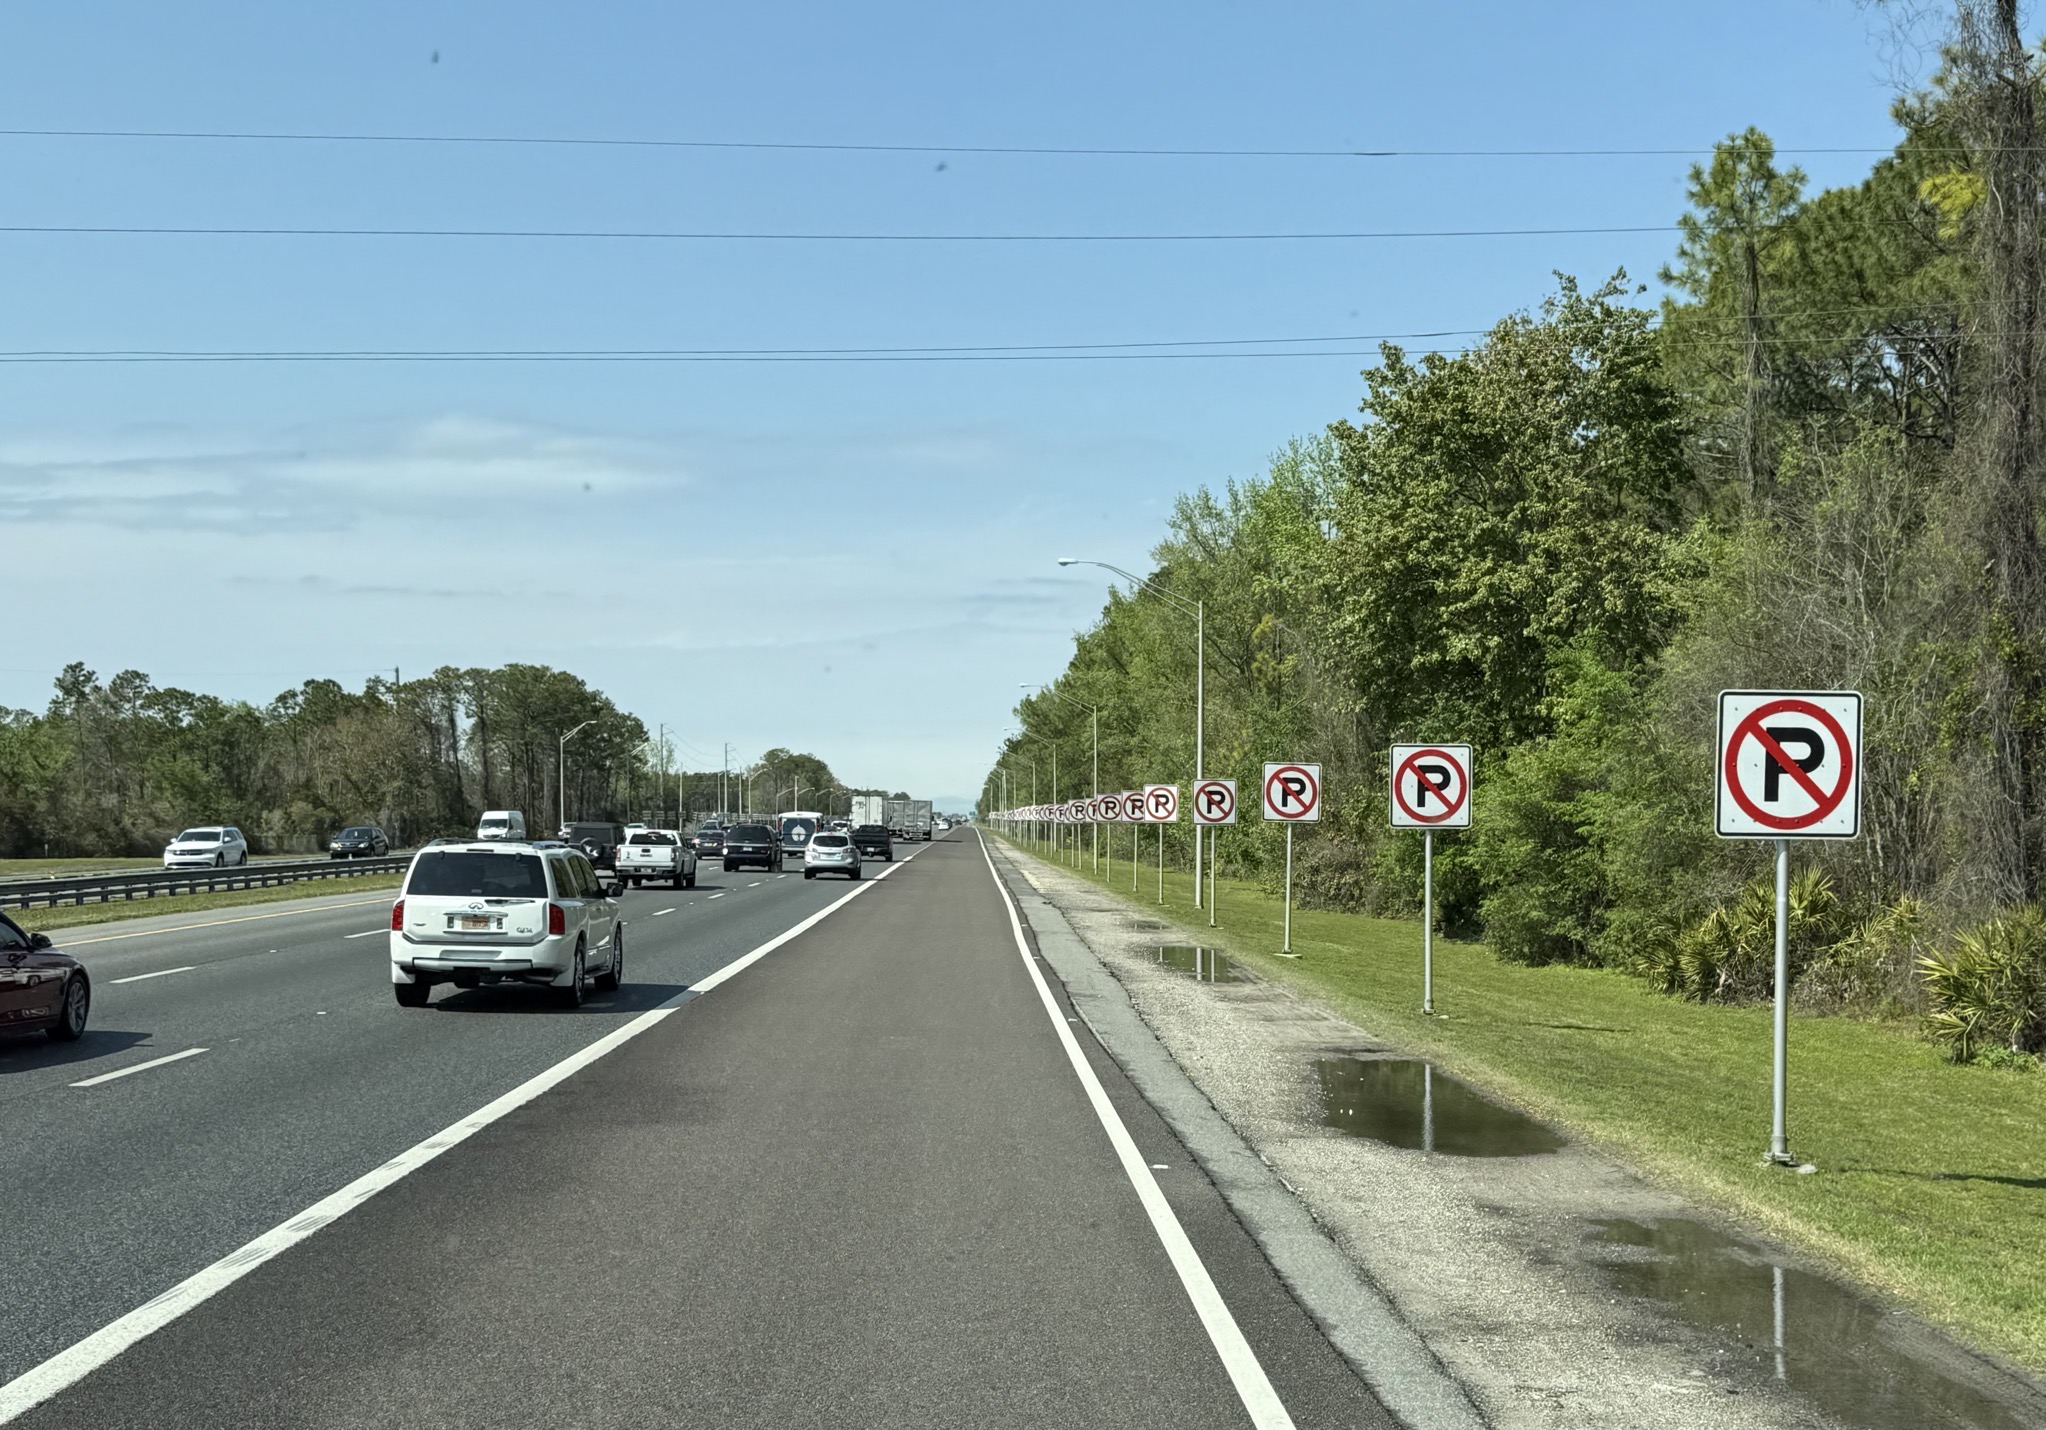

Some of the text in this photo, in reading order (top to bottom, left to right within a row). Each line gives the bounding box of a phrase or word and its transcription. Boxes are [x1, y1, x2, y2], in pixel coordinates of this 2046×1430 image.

[1764, 727, 1825, 802] P
[1281, 777, 1306, 807] P
[1417, 765, 1451, 808] P
[1155, 794, 1170, 813] P
[1206, 790, 1226, 814] P
